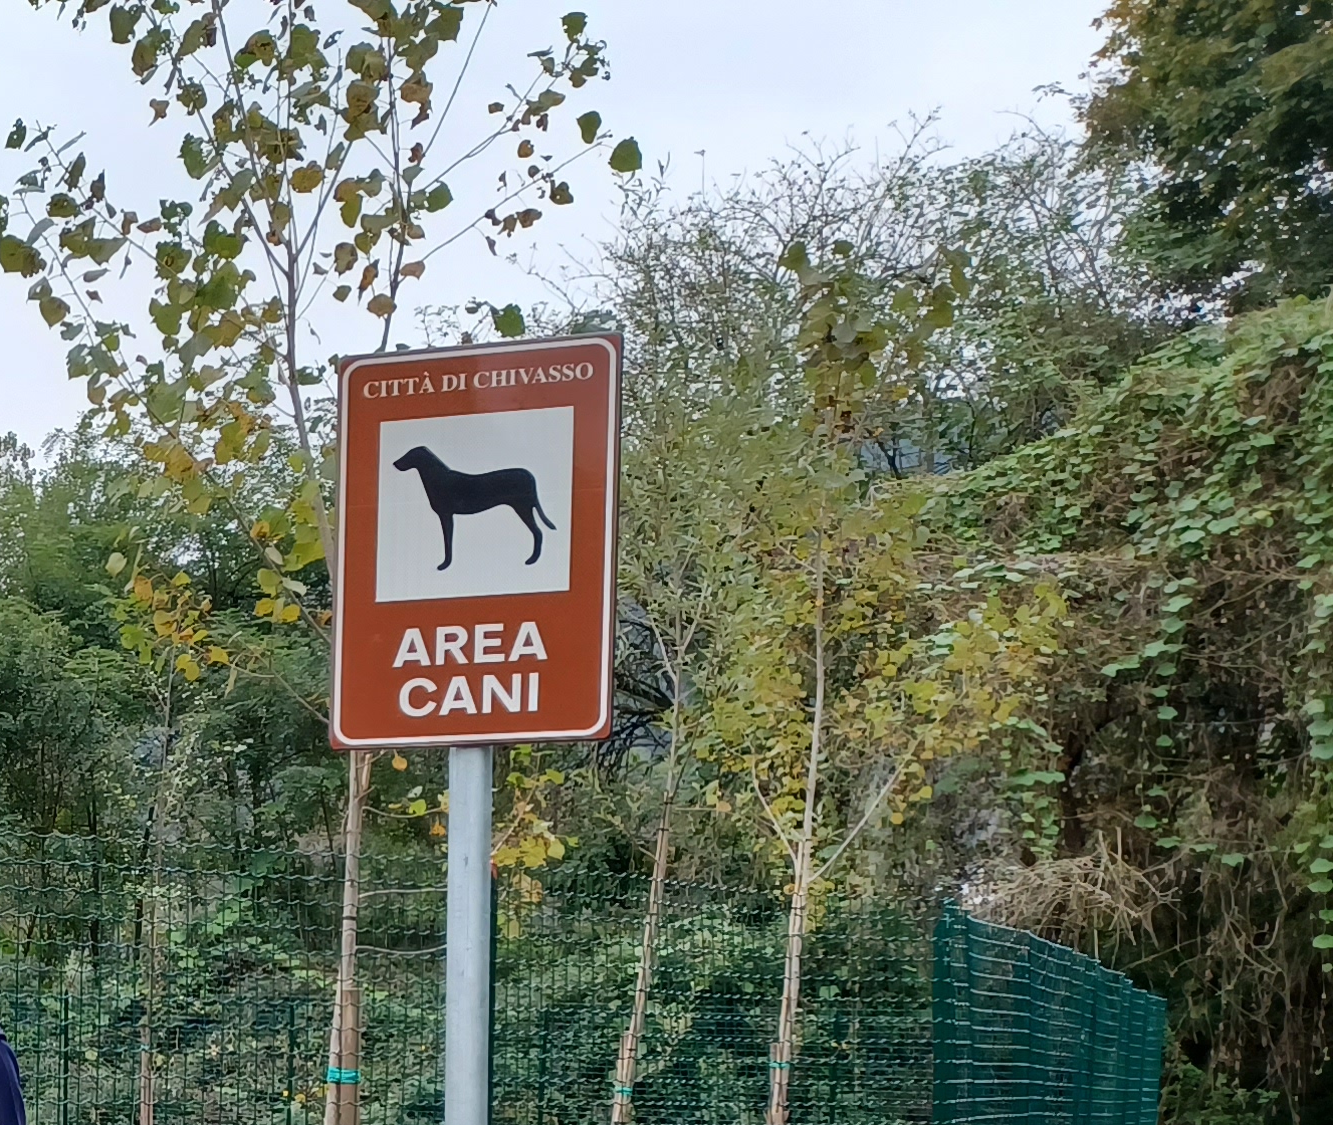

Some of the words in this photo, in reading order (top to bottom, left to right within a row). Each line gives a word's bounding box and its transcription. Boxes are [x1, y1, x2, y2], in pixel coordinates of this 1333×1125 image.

[363, 372, 434, 399] CITTÀ
[442, 373, 466, 392] DI
[473, 362, 594, 389] CHIVASSO
[392, 621, 547, 668] AREA
[399, 672, 539, 717] CANI
